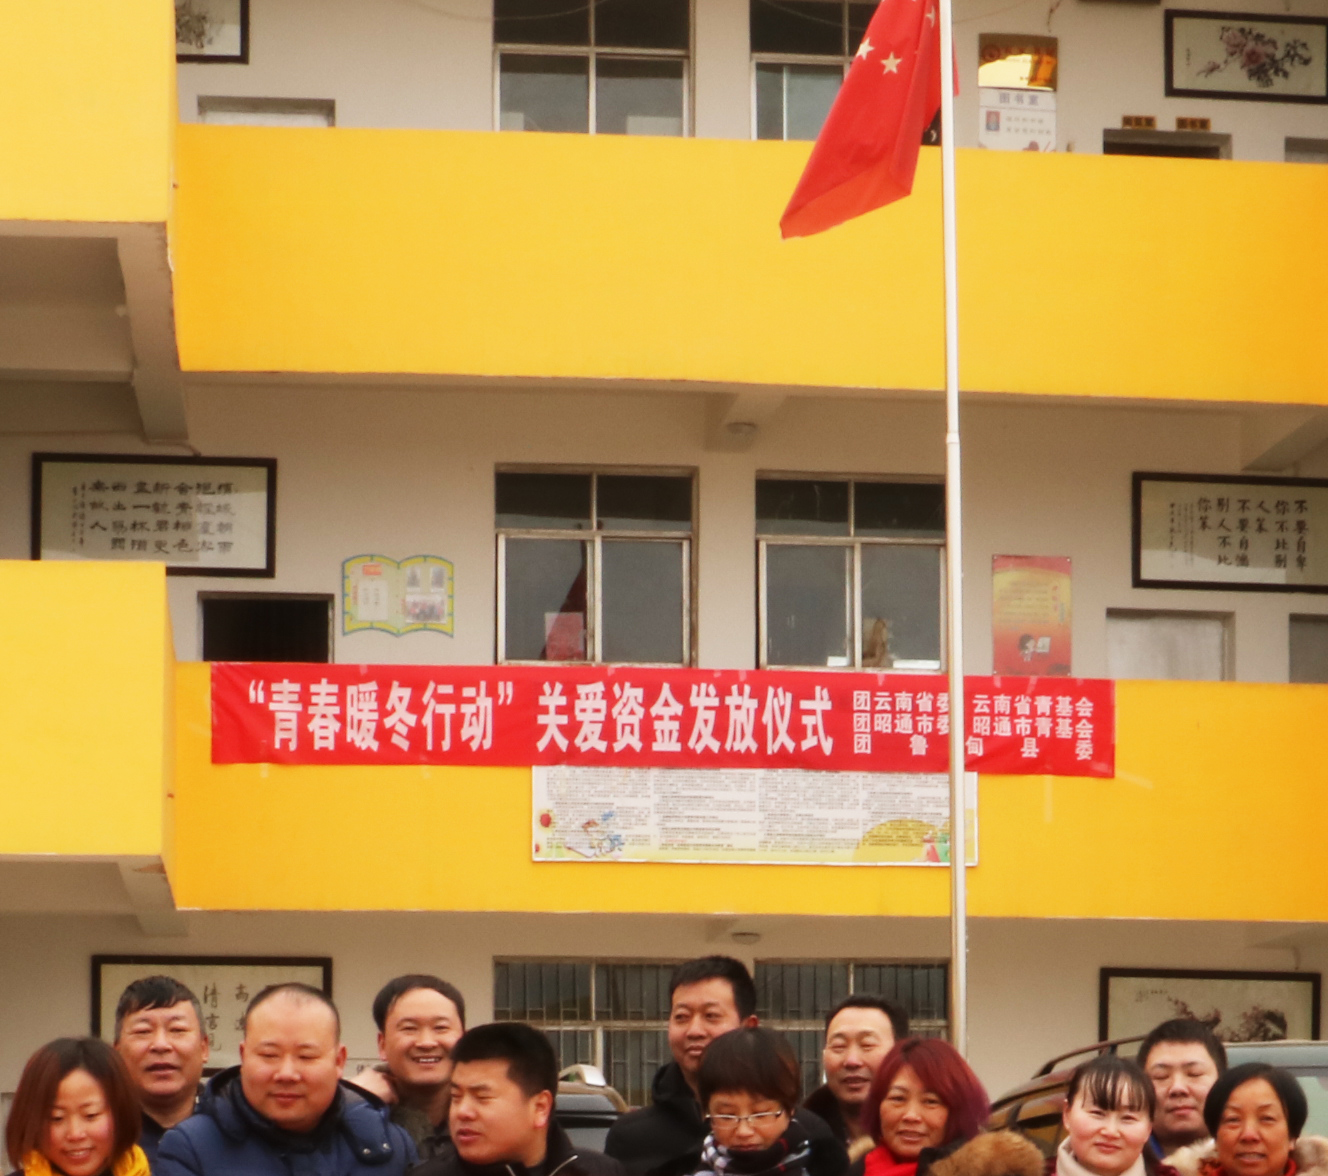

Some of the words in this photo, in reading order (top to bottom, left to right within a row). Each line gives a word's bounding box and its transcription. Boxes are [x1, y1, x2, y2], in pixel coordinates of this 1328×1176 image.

[249, 677, 514, 752] “青春暖冬行动”
[536, 681, 834, 756] 关爱资金发放仪式
[972, 694, 1094, 717] 云南省青基会
[972, 716, 1094, 739] 昭通市青基会
